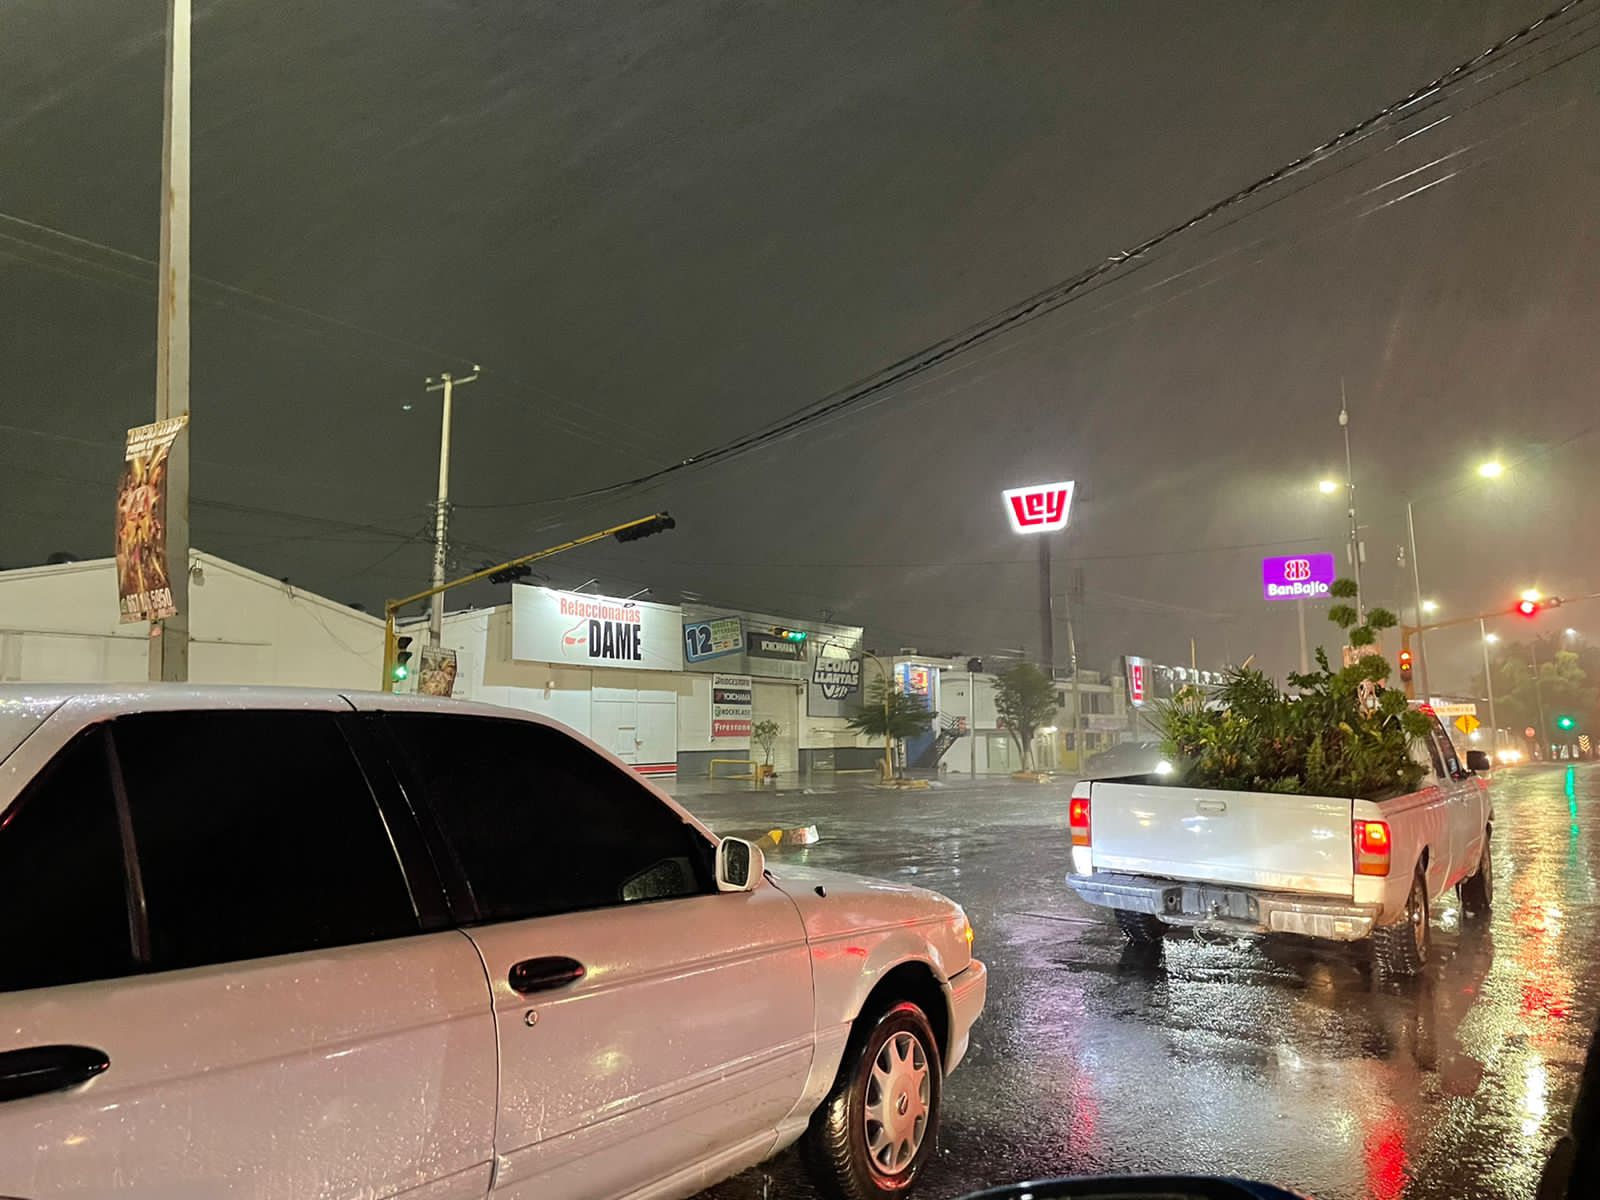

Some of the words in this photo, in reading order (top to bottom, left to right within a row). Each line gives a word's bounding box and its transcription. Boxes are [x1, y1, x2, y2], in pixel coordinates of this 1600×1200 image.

[1010, 490, 1067, 527] Ley
[560, 597, 641, 623] Refaccionarias
[588, 619, 642, 661] DAME
[686, 625, 713, 656] 12
[814, 671, 859, 686] LLANTAS
[815, 656, 860, 674] ECONO
